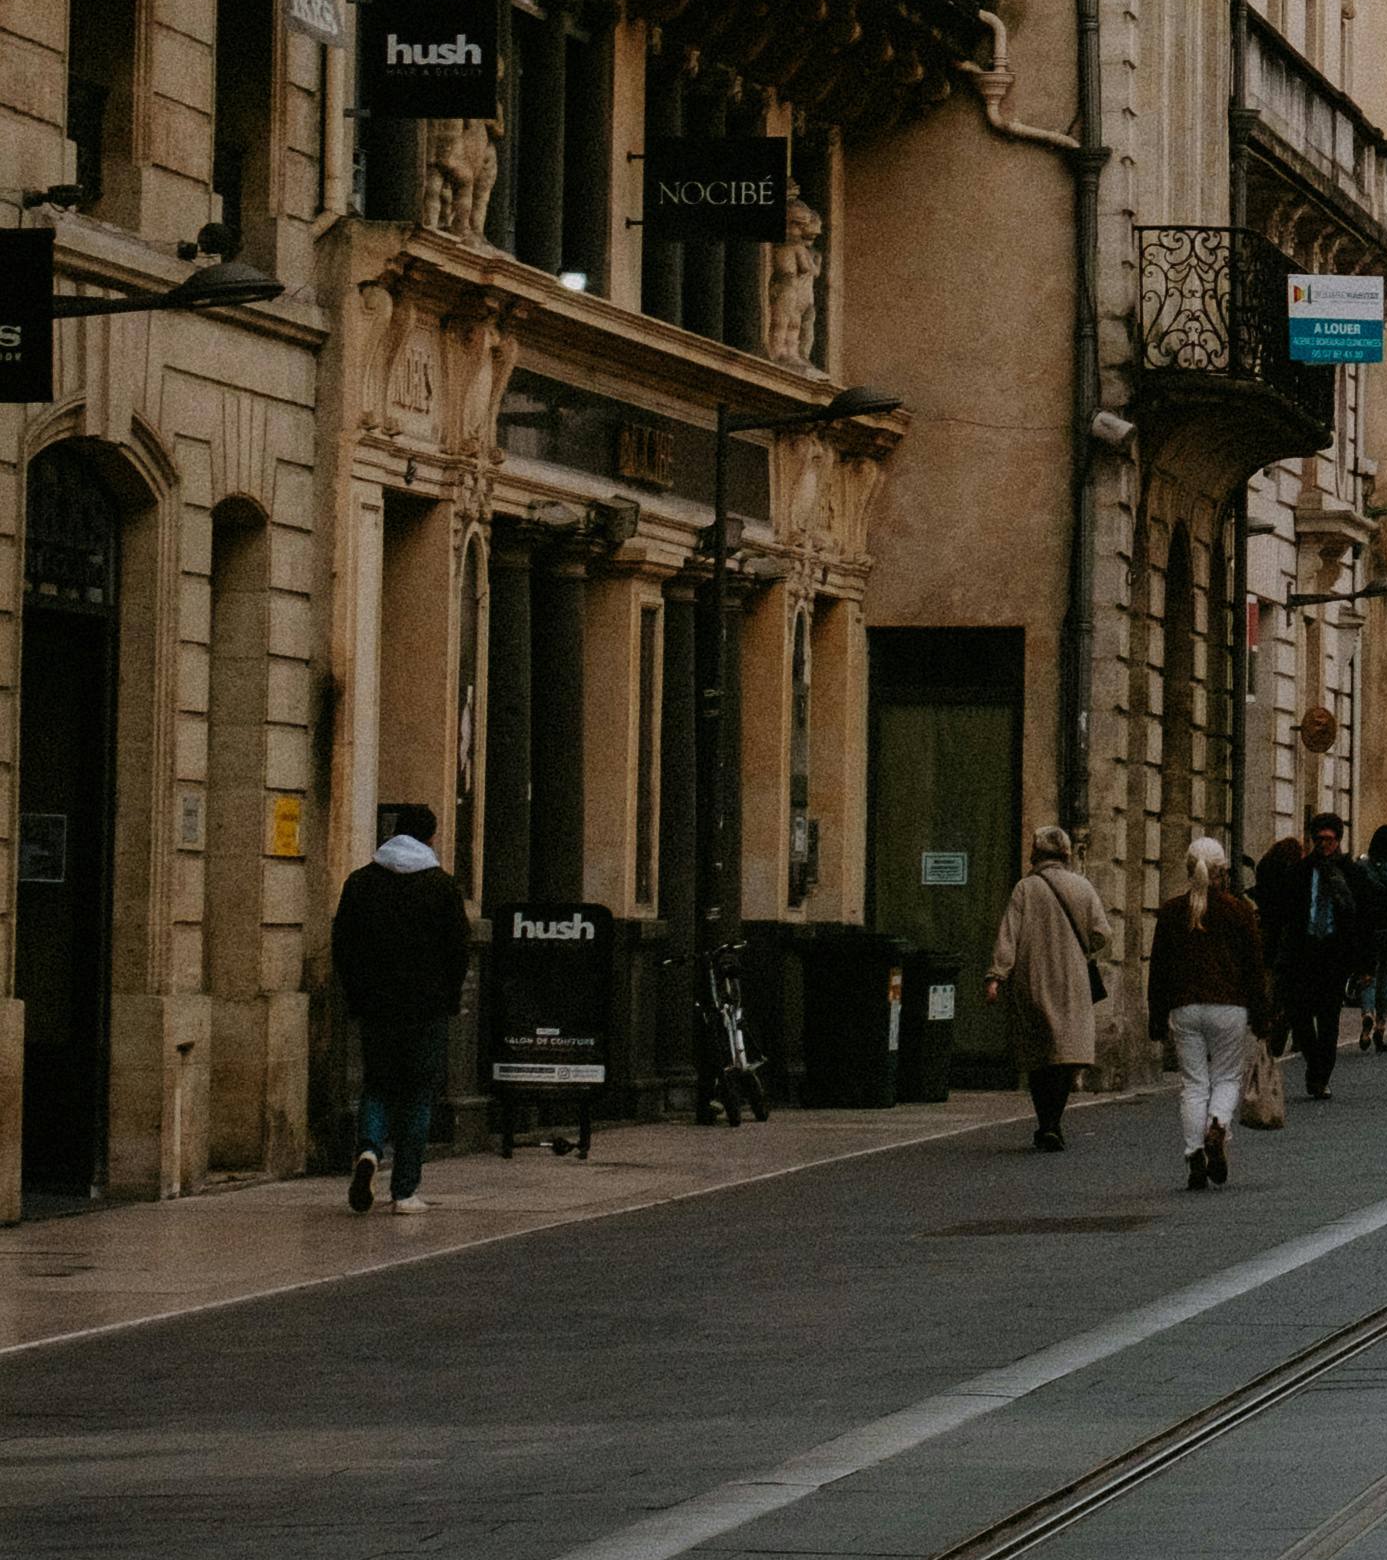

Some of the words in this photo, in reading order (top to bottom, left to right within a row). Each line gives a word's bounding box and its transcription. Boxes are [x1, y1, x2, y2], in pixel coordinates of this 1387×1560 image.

[386, 32, 482, 66] hush
[658, 176, 776, 206] NOCIBÉ
[1314, 323, 1322, 333] A
[1324, 323, 1361, 335] LOUER
[512, 911, 596, 941] hush
